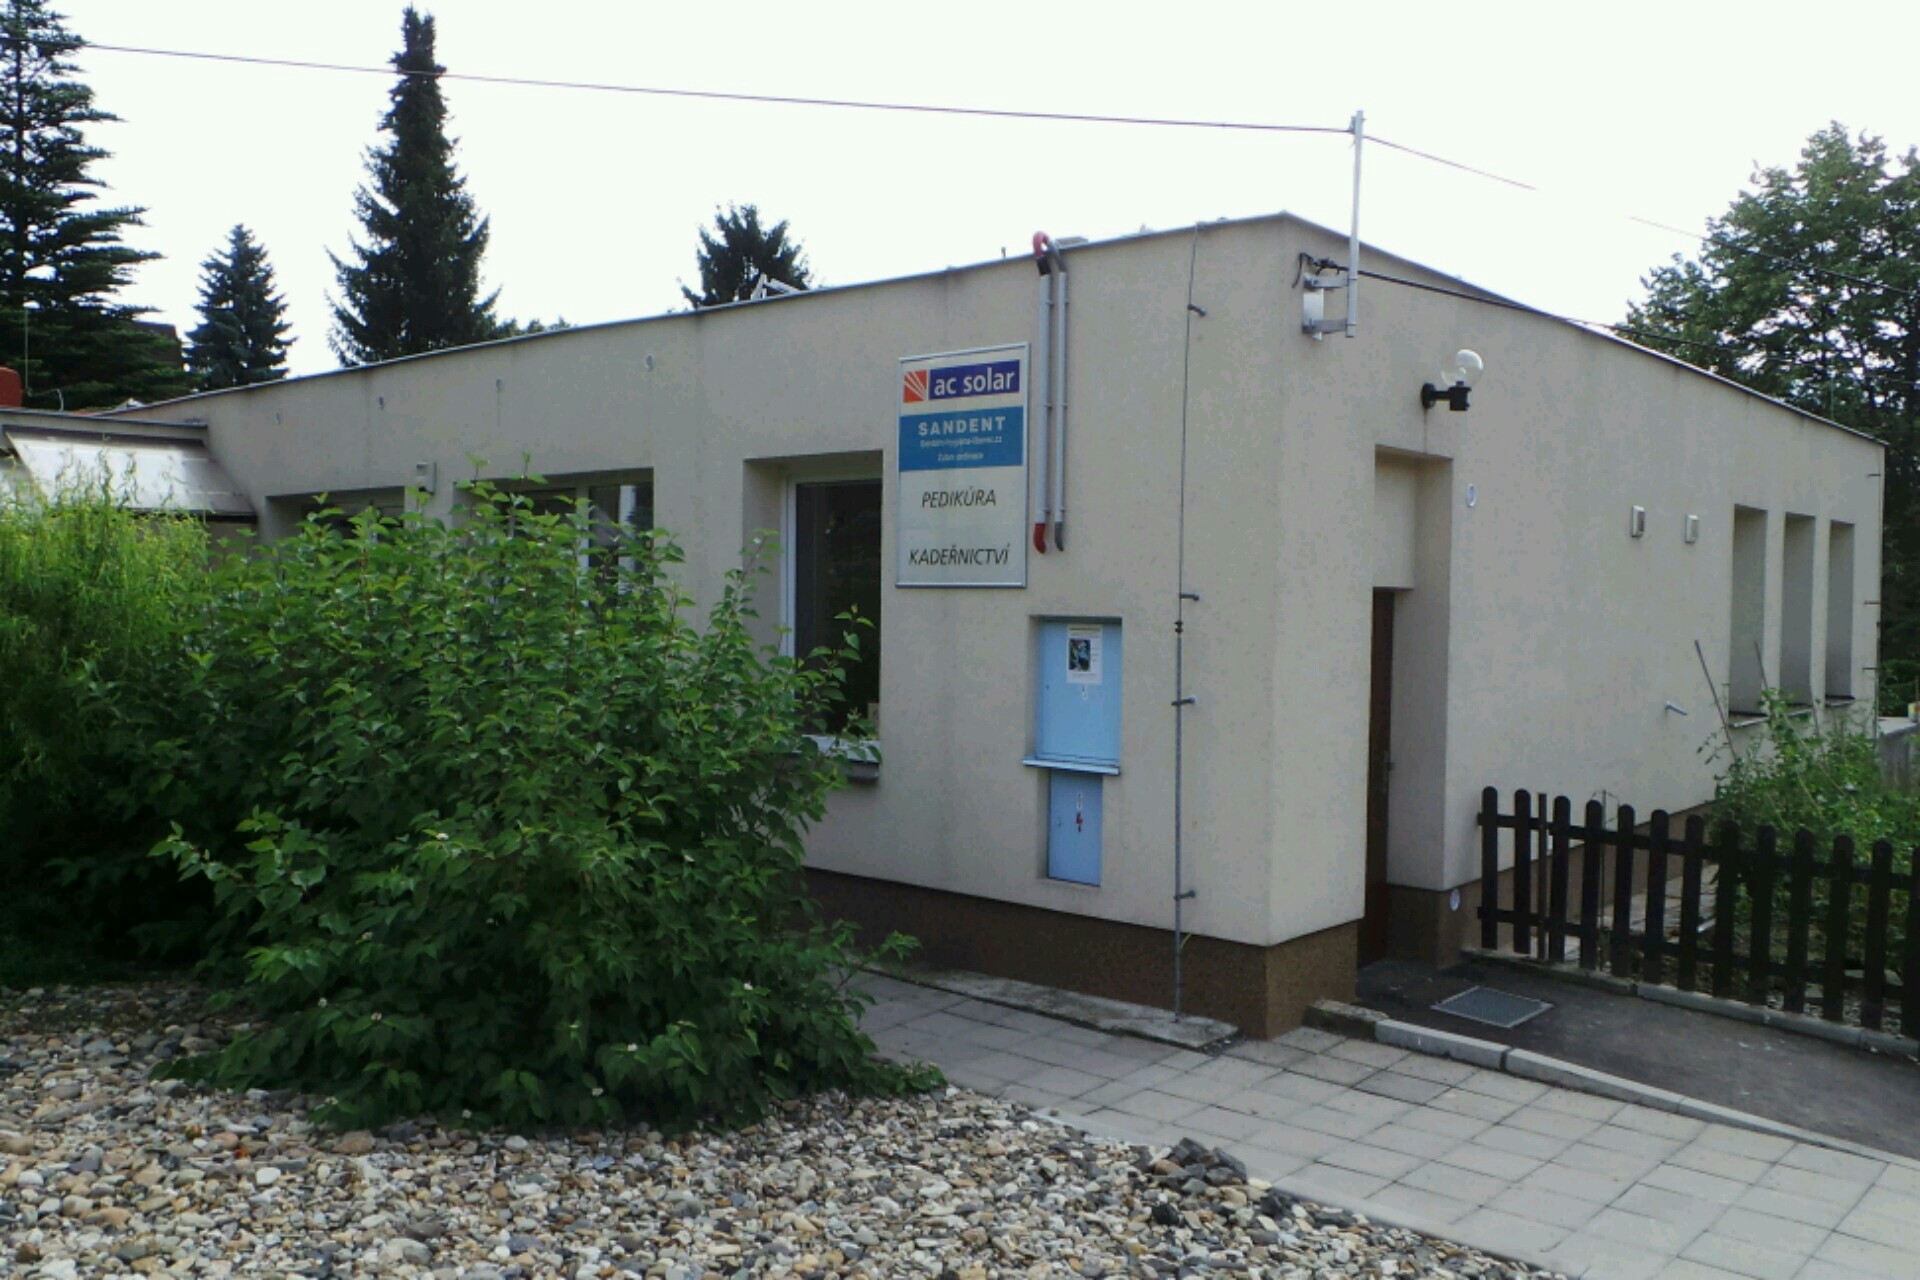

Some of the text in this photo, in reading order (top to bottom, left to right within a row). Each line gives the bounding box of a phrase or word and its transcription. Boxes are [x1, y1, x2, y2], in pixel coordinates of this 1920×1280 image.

[934, 366, 1015, 397] ac solar
[917, 416, 1006, 436] SANDENT
[922, 486, 996, 508] PEDIKÚRA
[909, 543, 1010, 566] KADEŘNICTVÍ
